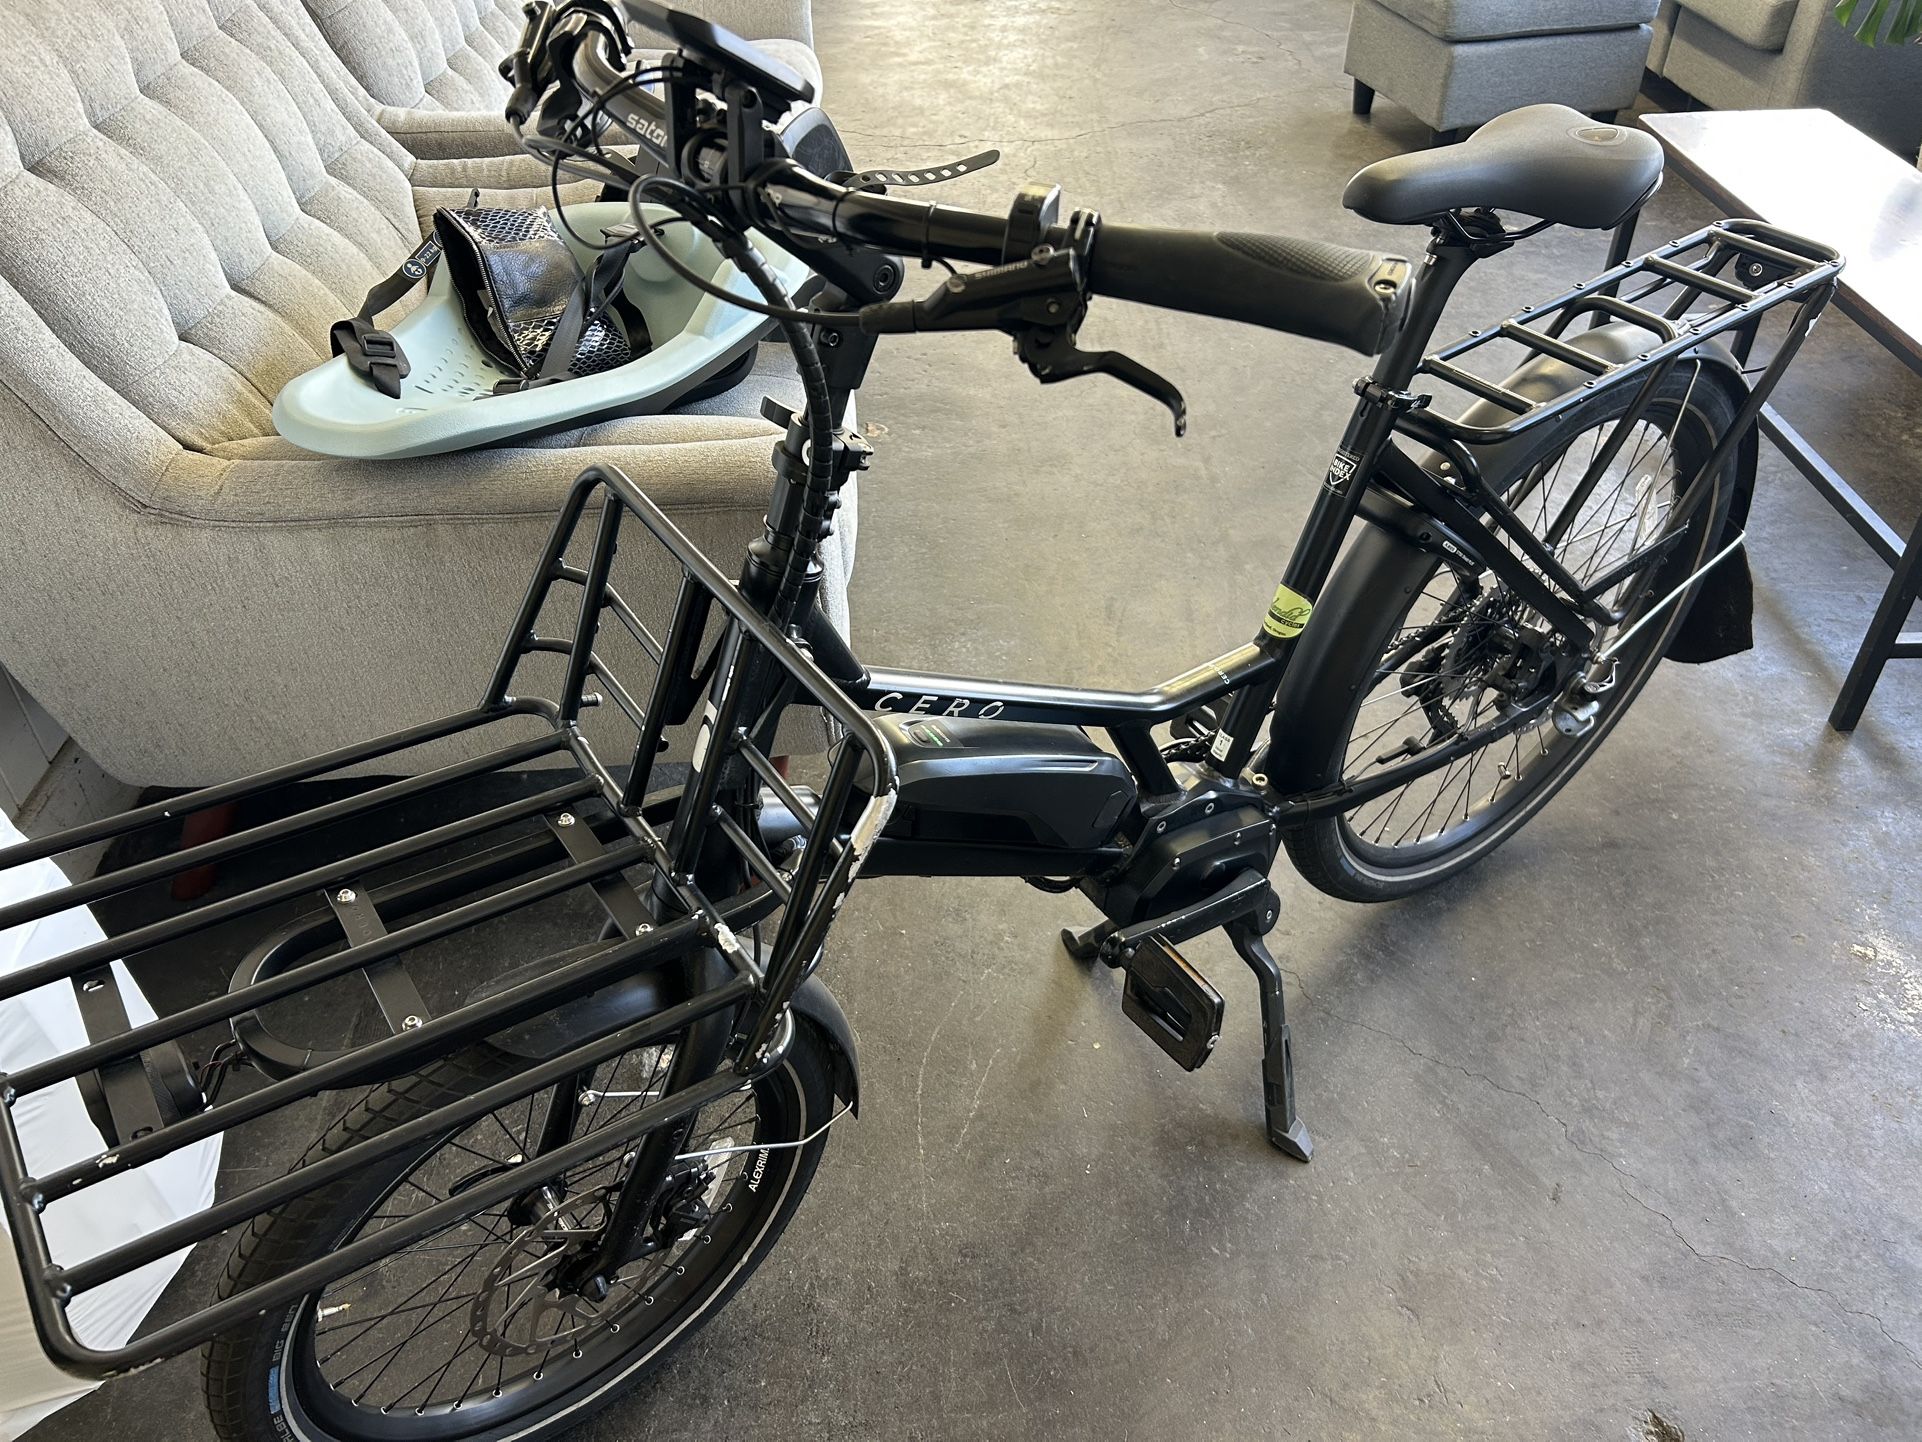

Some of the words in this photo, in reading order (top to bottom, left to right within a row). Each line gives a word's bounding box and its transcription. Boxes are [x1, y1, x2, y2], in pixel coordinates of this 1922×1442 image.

[1334, 458, 1351, 473] BIKE
[874, 691, 1006, 720] CERO
[748, 1146, 770, 1193] ALEXRIM
